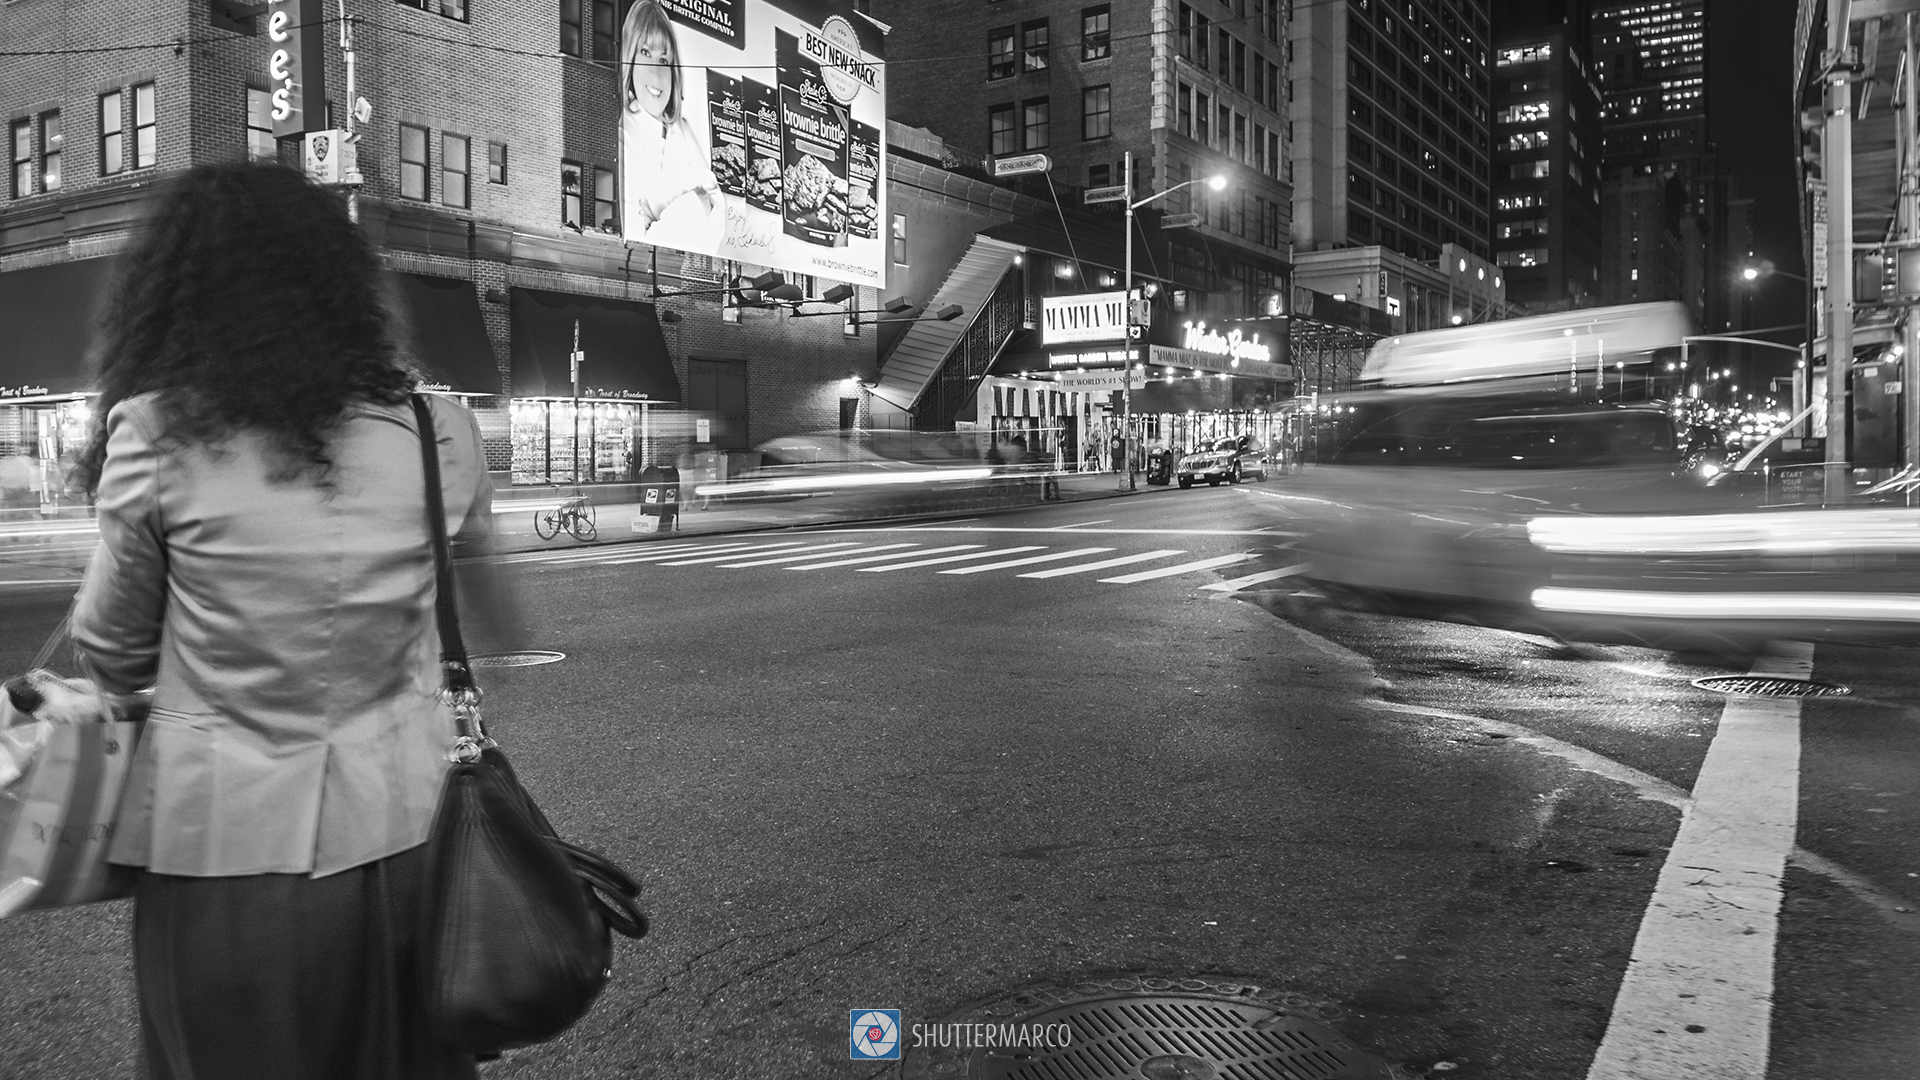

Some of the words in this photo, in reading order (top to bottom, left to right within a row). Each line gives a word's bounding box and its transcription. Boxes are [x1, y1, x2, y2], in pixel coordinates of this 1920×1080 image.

[673, 4, 700, 22] BRITTLE
[680, 0, 732, 26] RIGINAL
[268, 0, 293, 121] ee's
[806, 32, 827, 60] BEST
[829, 45, 848, 71] NEW
[849, 58, 876, 88] SNACK
[711, 112, 735, 131] brownie
[736, 120, 745, 134] bri
[747, 122, 771, 143] brownie
[771, 131, 780, 147] bri
[783, 102, 819, 135] brownie
[820, 117, 846, 144] brittle
[1045, 304, 1100, 331] MAMMA
[1105, 302, 1124, 327] MI
[1183, 320, 1230, 356] Winter
[15, 387, 21, 398] of
[22, 384, 48, 396] Broadway
[598, 388, 613, 397] Toast
[614, 390, 621, 399] of
[622, 389, 649, 400] Broadway
[1063, 379, 1075, 387] THE
[1077, 377, 1107, 386] WORLD'S
[1108, 376, 1116, 385] #1
[1782, 478, 1802, 486] YOUR
